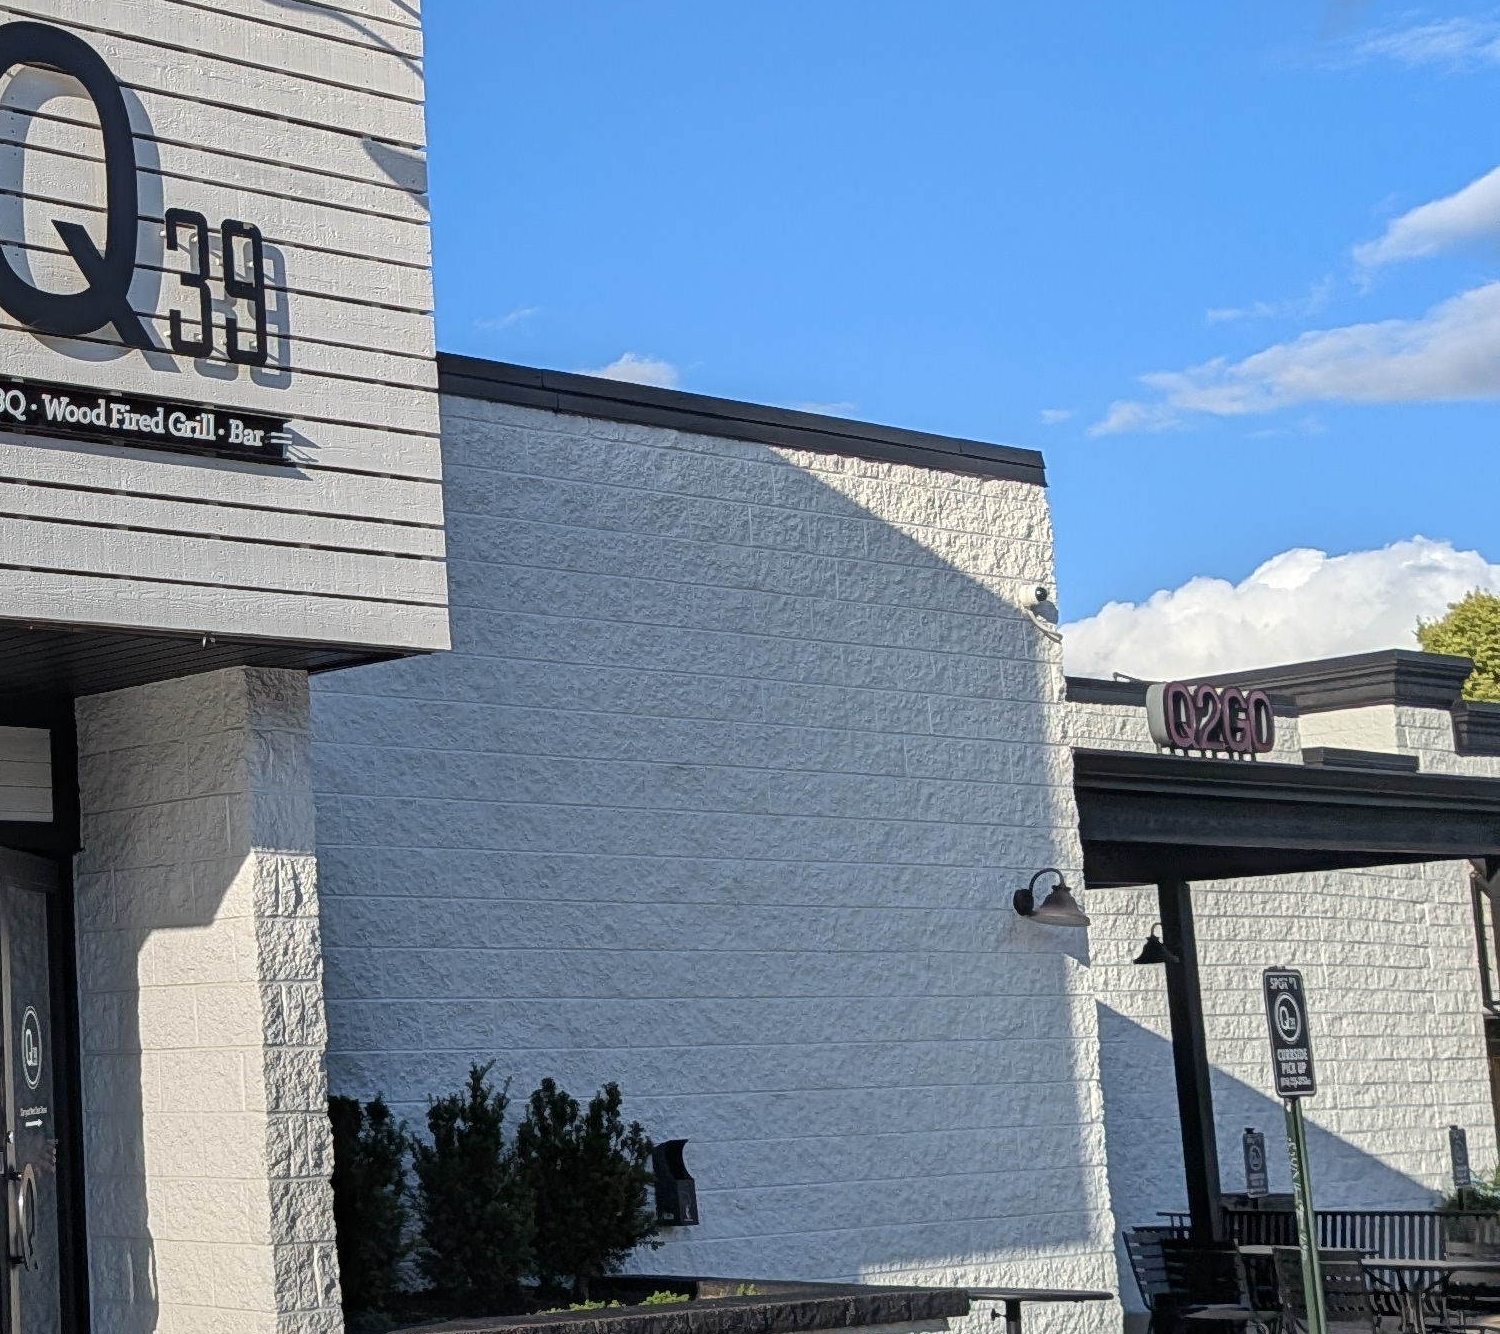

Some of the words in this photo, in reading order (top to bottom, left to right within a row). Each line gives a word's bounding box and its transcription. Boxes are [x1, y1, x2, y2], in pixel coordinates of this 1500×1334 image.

[42, 394, 107, 427] Wood
[110, 403, 166, 434] Fired
[168, 412, 217, 441] Grill
[228, 419, 265, 447] Bar
[1163, 681, 1275, 753] Q2GO
